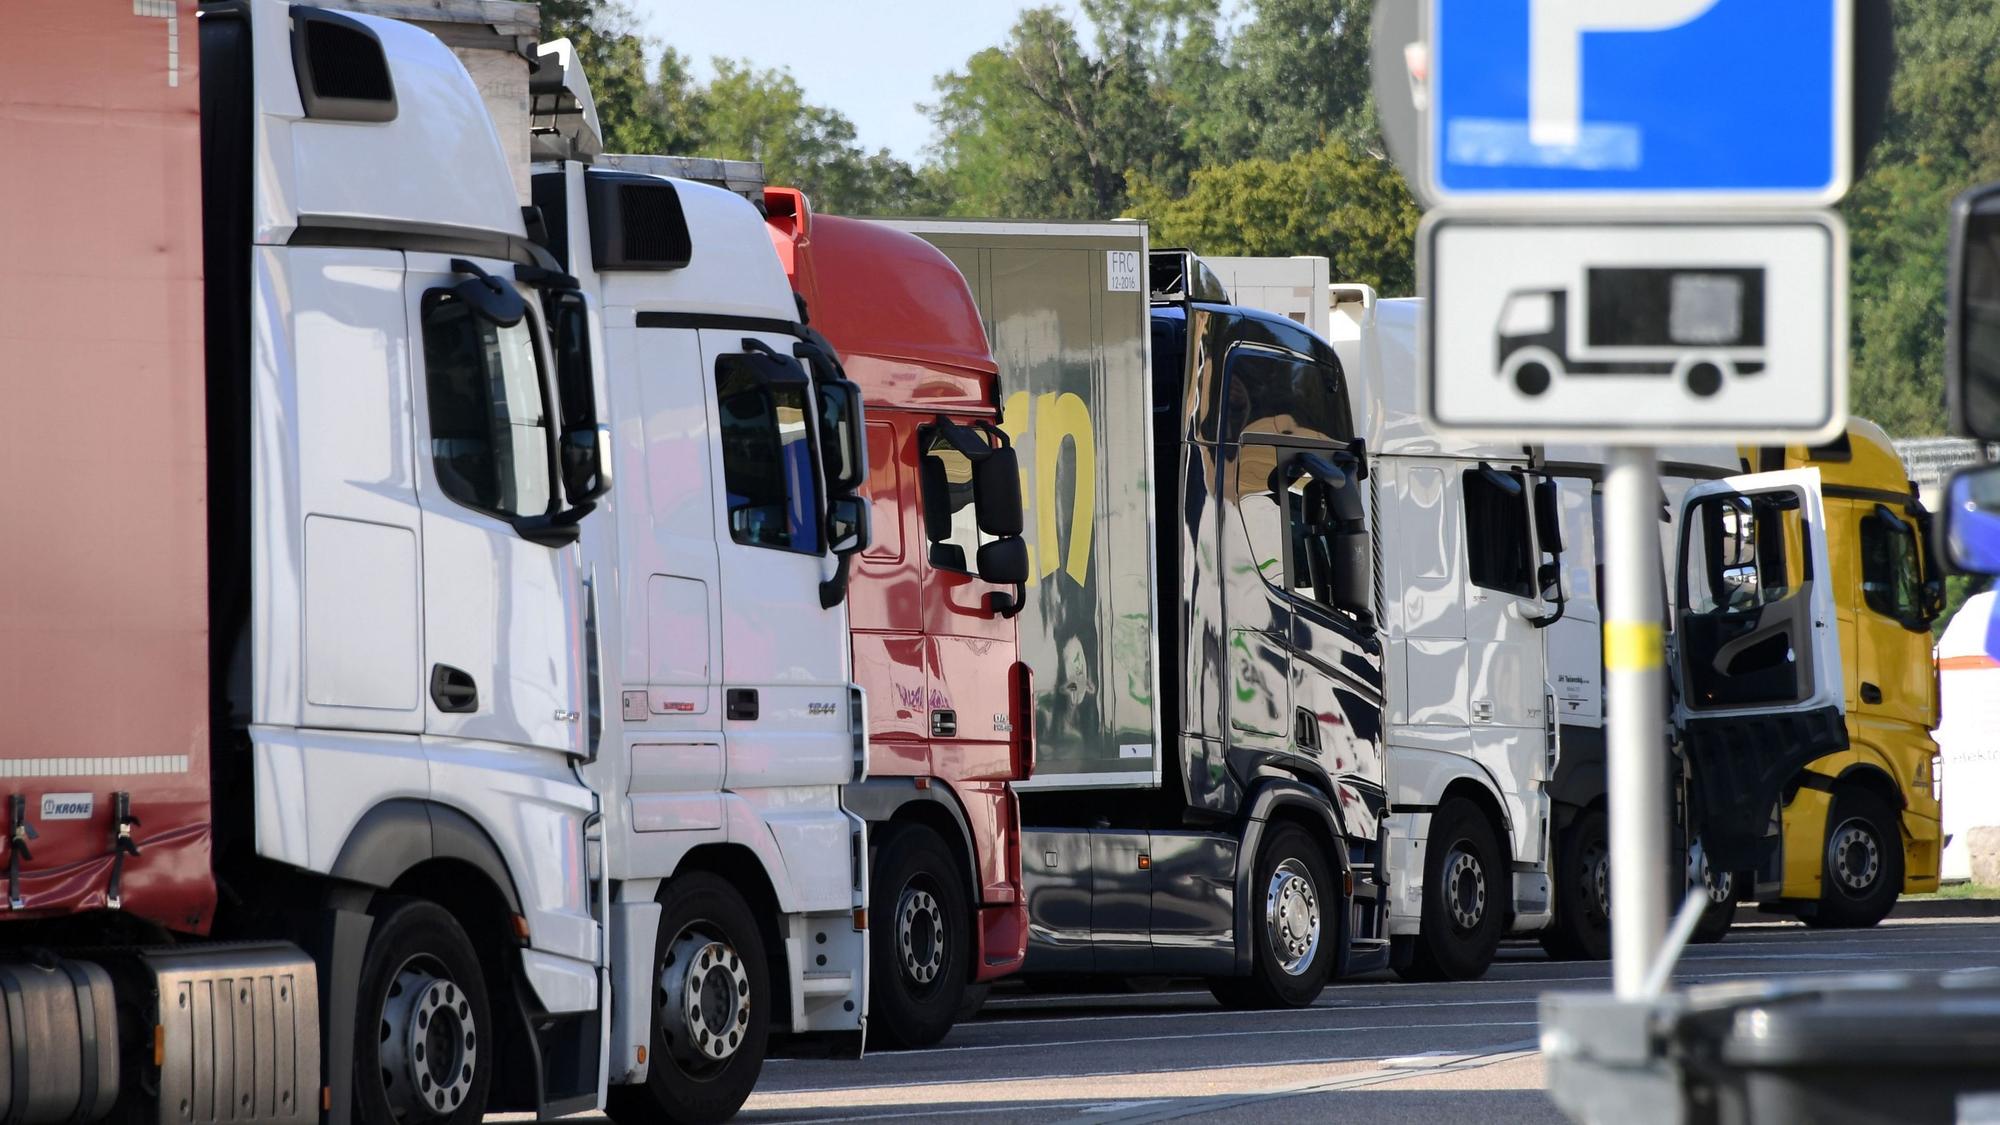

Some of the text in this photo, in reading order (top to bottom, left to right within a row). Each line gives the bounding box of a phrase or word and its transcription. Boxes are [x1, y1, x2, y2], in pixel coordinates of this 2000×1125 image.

[1112, 251, 1134, 273] FRC
[1112, 276, 1136, 289] 12-2016
[55, 802, 91, 815] KRONE
